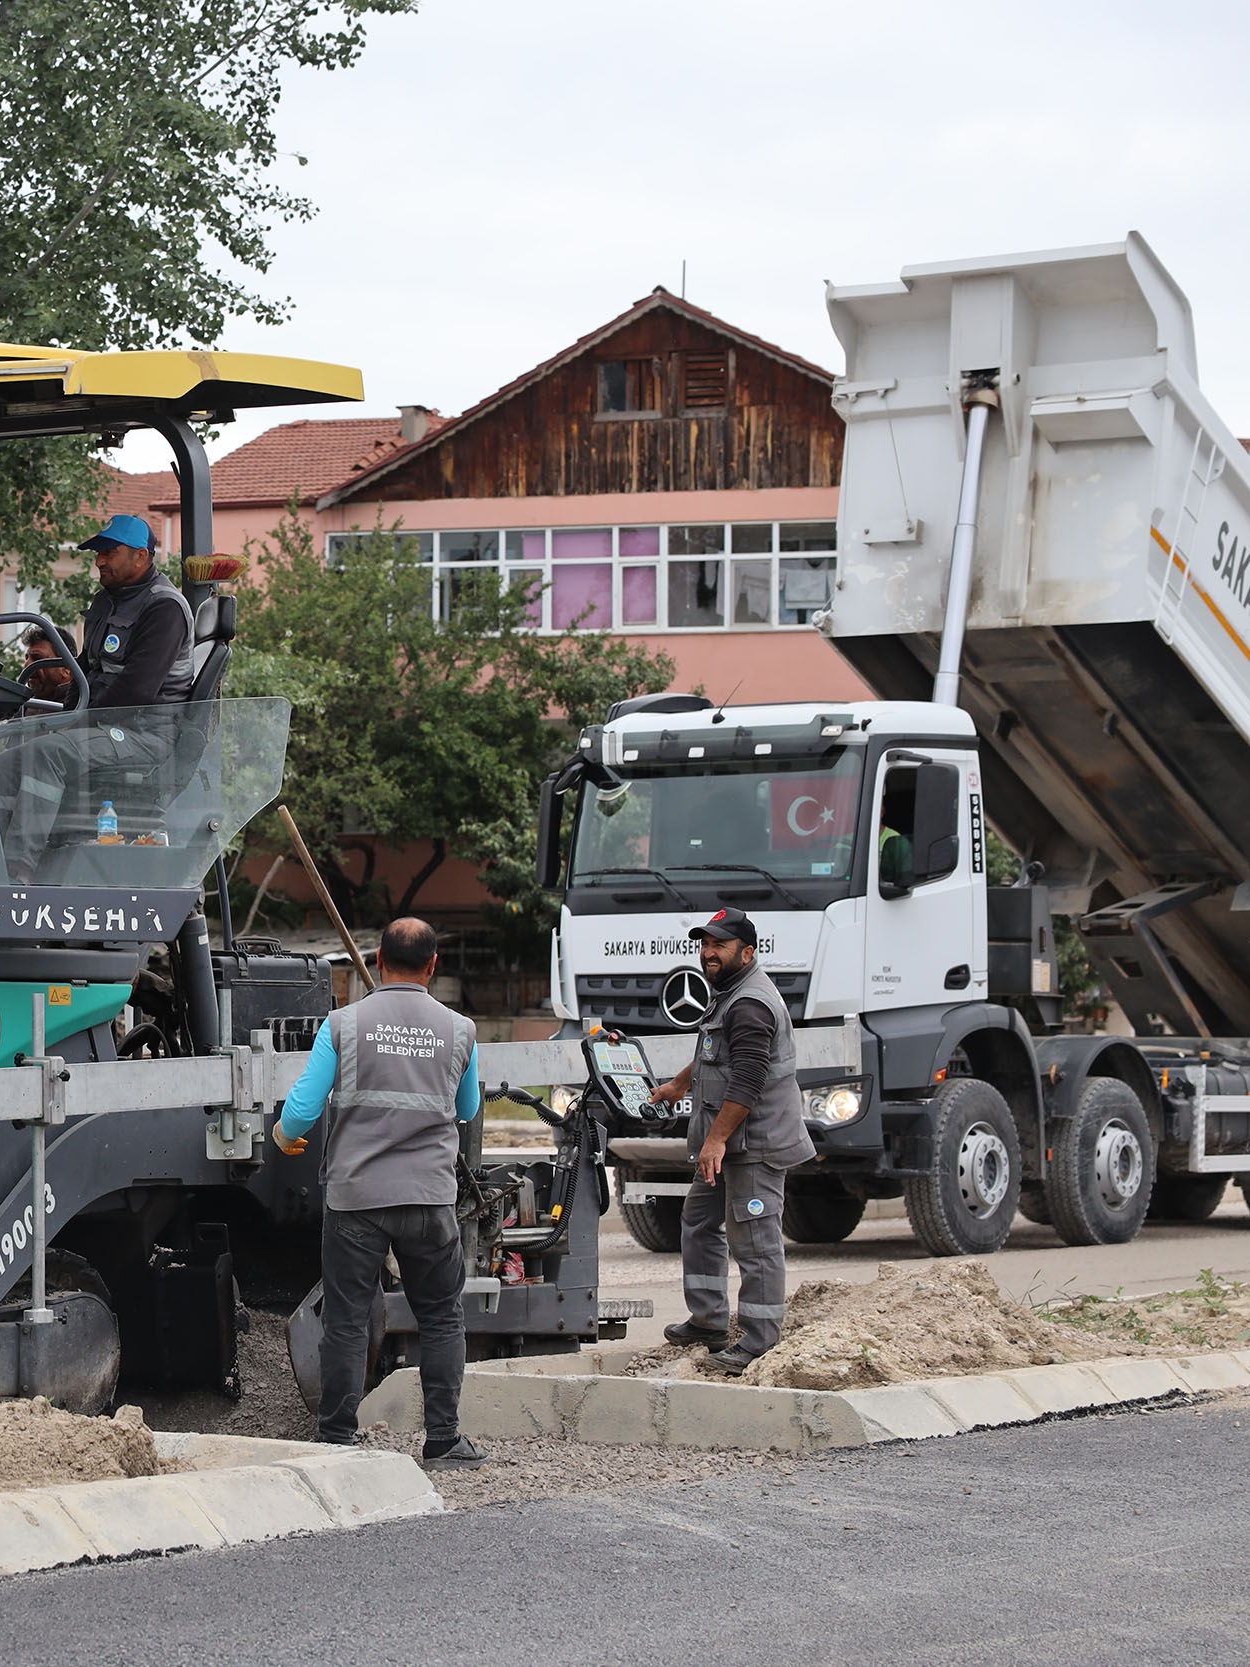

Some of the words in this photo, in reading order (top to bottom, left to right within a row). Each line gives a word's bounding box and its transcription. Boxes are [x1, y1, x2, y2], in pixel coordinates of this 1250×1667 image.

[604, 941, 645, 956] SAKARYA
[376, 1023, 435, 1037] SAKARYA
[365, 1031, 446, 1048] BÜYÜKŞEHİR
[376, 1043, 435, 1058] BELEDİYESİ
